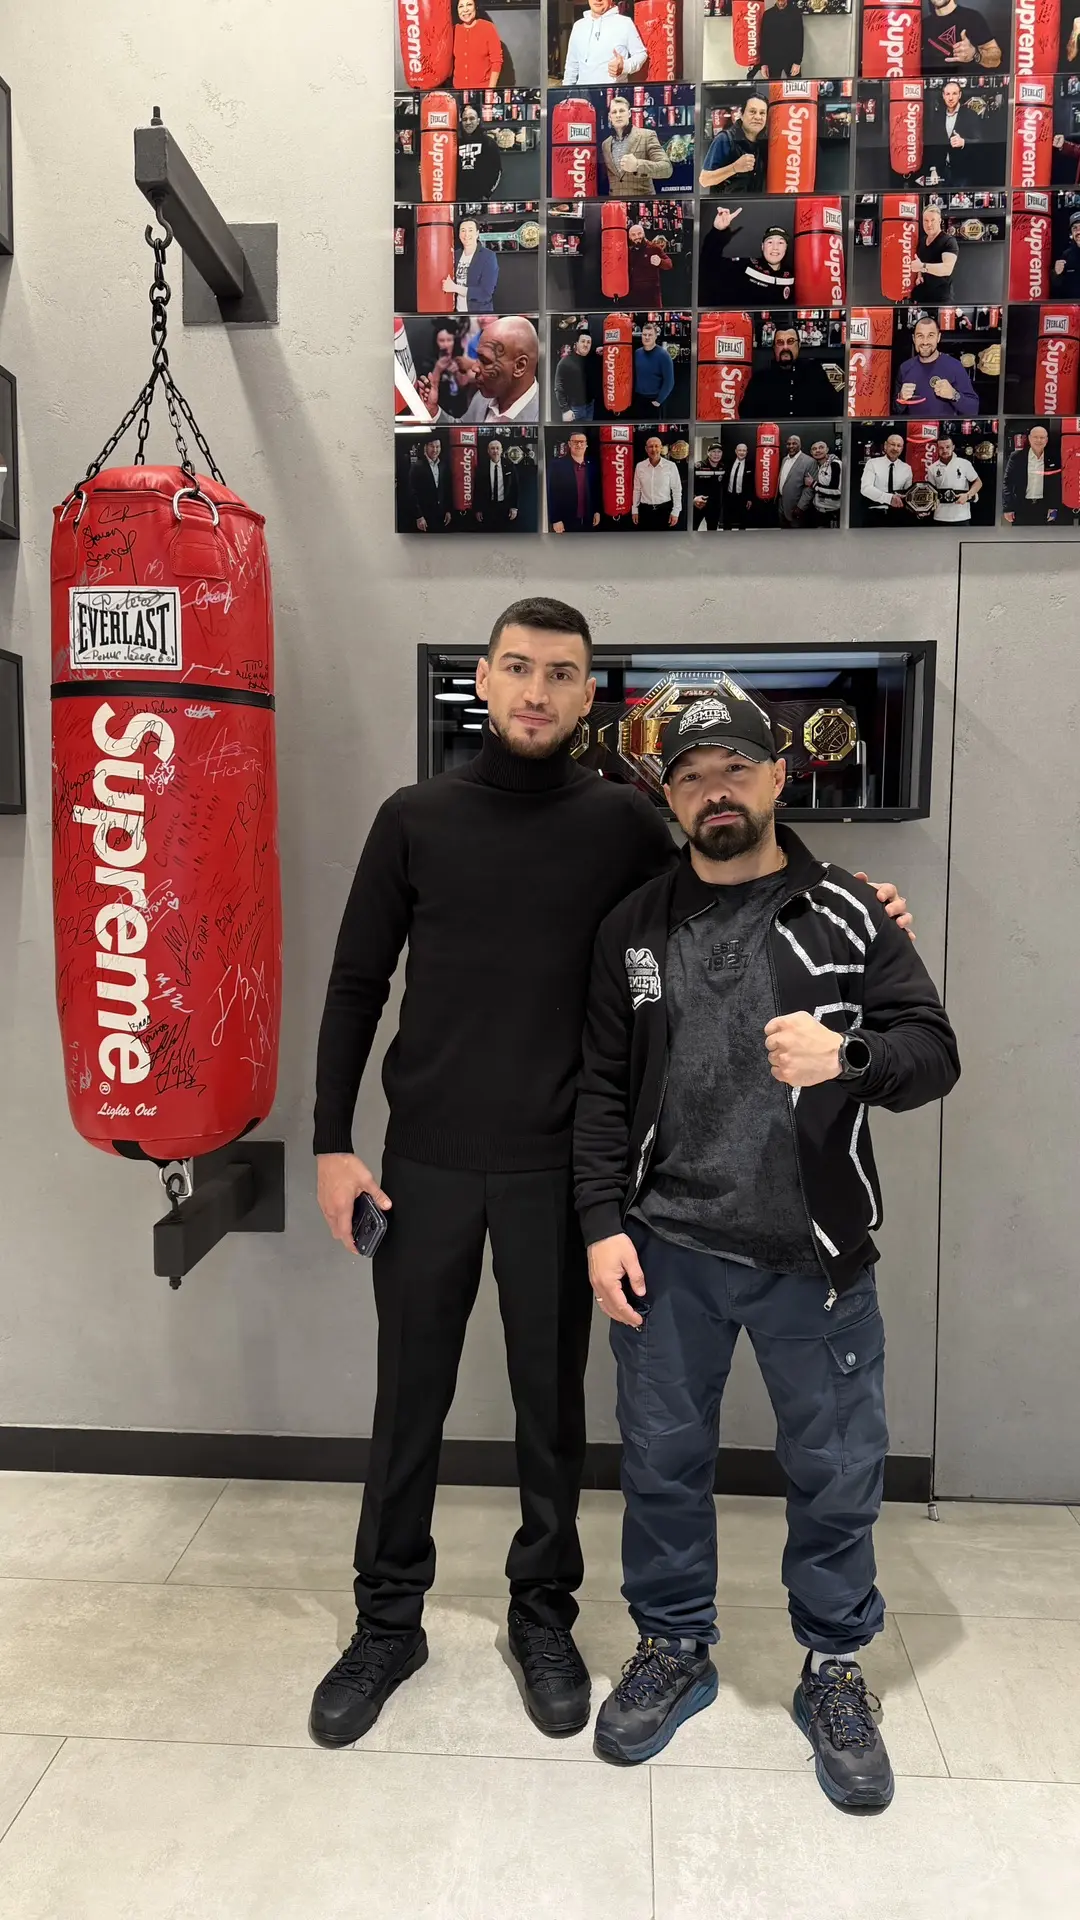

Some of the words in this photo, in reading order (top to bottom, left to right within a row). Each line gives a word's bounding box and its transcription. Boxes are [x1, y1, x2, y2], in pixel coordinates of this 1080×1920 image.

[744, 2, 760, 57] Supreme
[782, 104, 808, 193] Supreme
[904, 102, 920, 163] Supreme
[1016, 106, 1044, 188] Supreme
[428, 133, 448, 201] Supreme
[1023, 216, 1047, 297] Supreme
[604, 345, 620, 402] Supreme
[717, 340, 743, 355] EVERLAST
[1041, 339, 1066, 414] Suprem
[460, 447, 475, 501] Supreme
[609, 445, 629, 505] Supreme
[760, 447, 774, 493] Supreme
[77, 602, 170, 655] EVERLAST
[679, 709, 730, 732] PREMIER
[72, 702, 176, 1085] Supreme
[703, 952, 753, 971] 1927
[97, 1101, 131, 1120] Lights
[134, 1102, 158, 1117] Out
